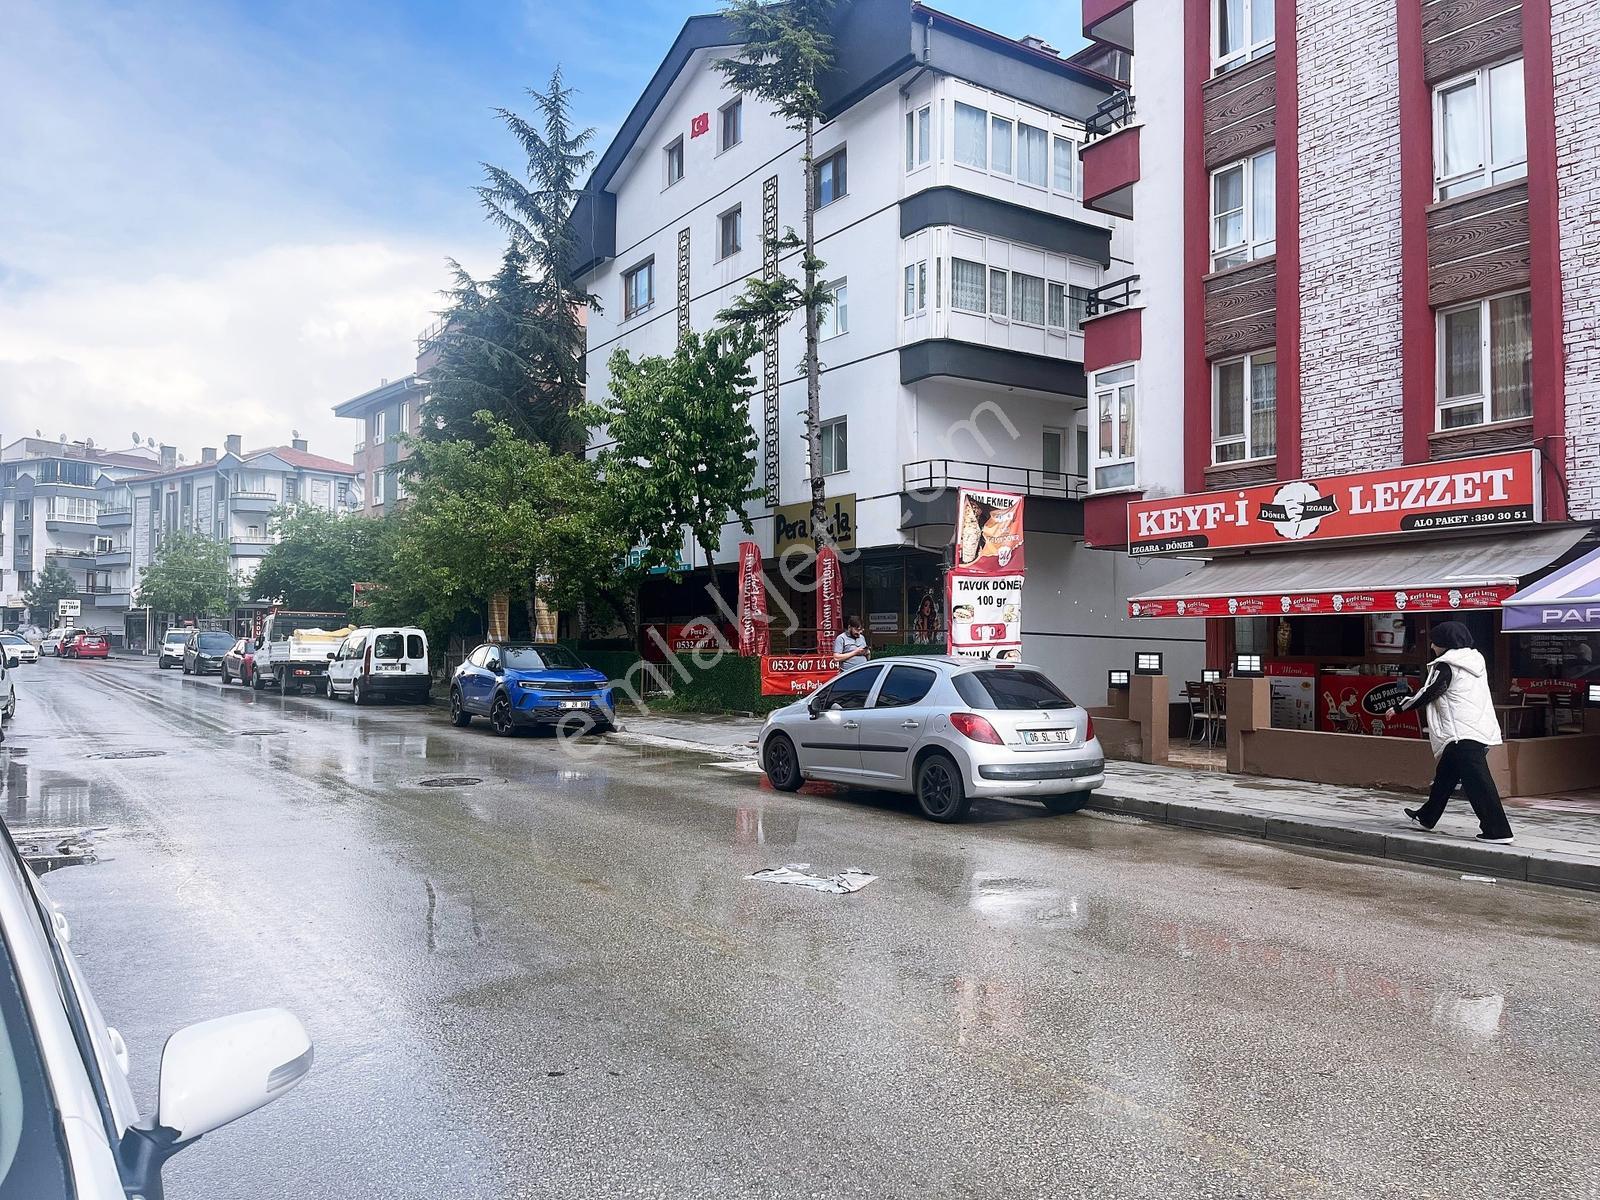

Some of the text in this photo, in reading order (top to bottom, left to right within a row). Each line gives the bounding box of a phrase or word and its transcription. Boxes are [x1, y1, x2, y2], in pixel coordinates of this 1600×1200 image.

[987, 496, 1013, 508] EKMEK
[1138, 468, 1513, 537] KEYF-İ LEZZET
[1306, 504, 1333, 512] IZGARA
[1261, 510, 1286, 520] DÖNER
[1414, 518, 1433, 527] ALO
[1435, 515, 1469, 526] PAKET
[1497, 511, 1511, 520] 30
[1514, 510, 1527, 519] 51
[776, 514, 808, 544] Pera
[1132, 544, 1160, 554] IZGARA
[1165, 540, 1194, 551] DÖNER
[958, 580, 990, 591] TAVUK
[977, 596, 1007, 607] 100 gr
[676, 641, 694, 649] 0532
[772, 660, 794, 671] 0532
[797, 660, 813, 670] 607
[817, 660, 826, 669] 14
[791, 681, 806, 691] Pera
[1370, 688, 1398, 702] ALO PAKE
[1373, 701, 1386, 711] 330
[1387, 699, 1396, 707] 30
[1030, 732, 1068, 742] 06 SL 972
